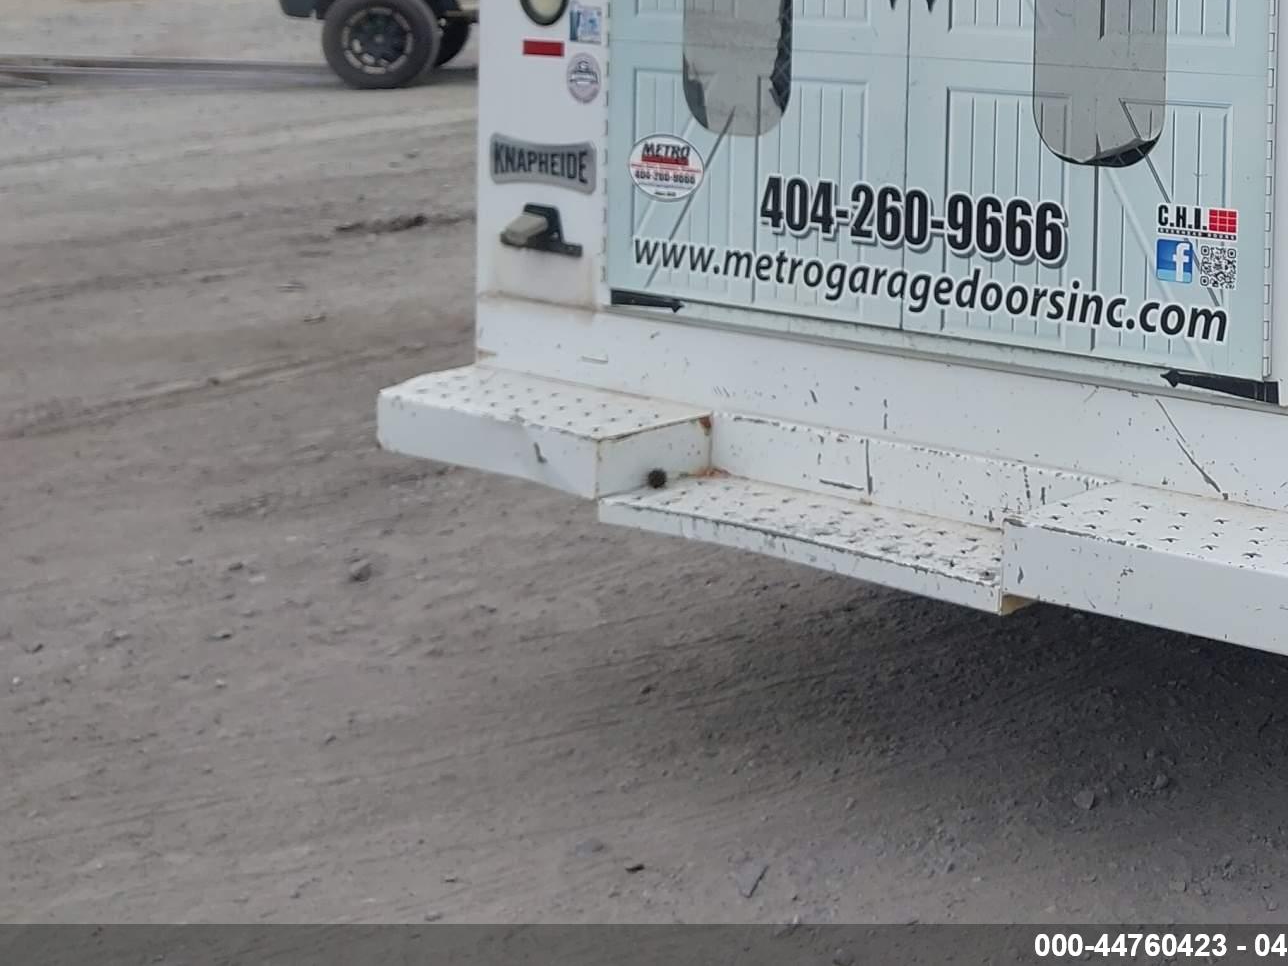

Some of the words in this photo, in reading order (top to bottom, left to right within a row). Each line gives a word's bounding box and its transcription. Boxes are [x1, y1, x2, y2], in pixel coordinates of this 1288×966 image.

[493, 141, 588, 185] KNAPHEIDE
[642, 142, 690, 159] METRO
[759, 174, 1069, 266] 404-260-9666
[1158, 204, 1208, 231] C.H.I.
[634, 236, 1228, 343] www.metrogaragedoorsinc.com
